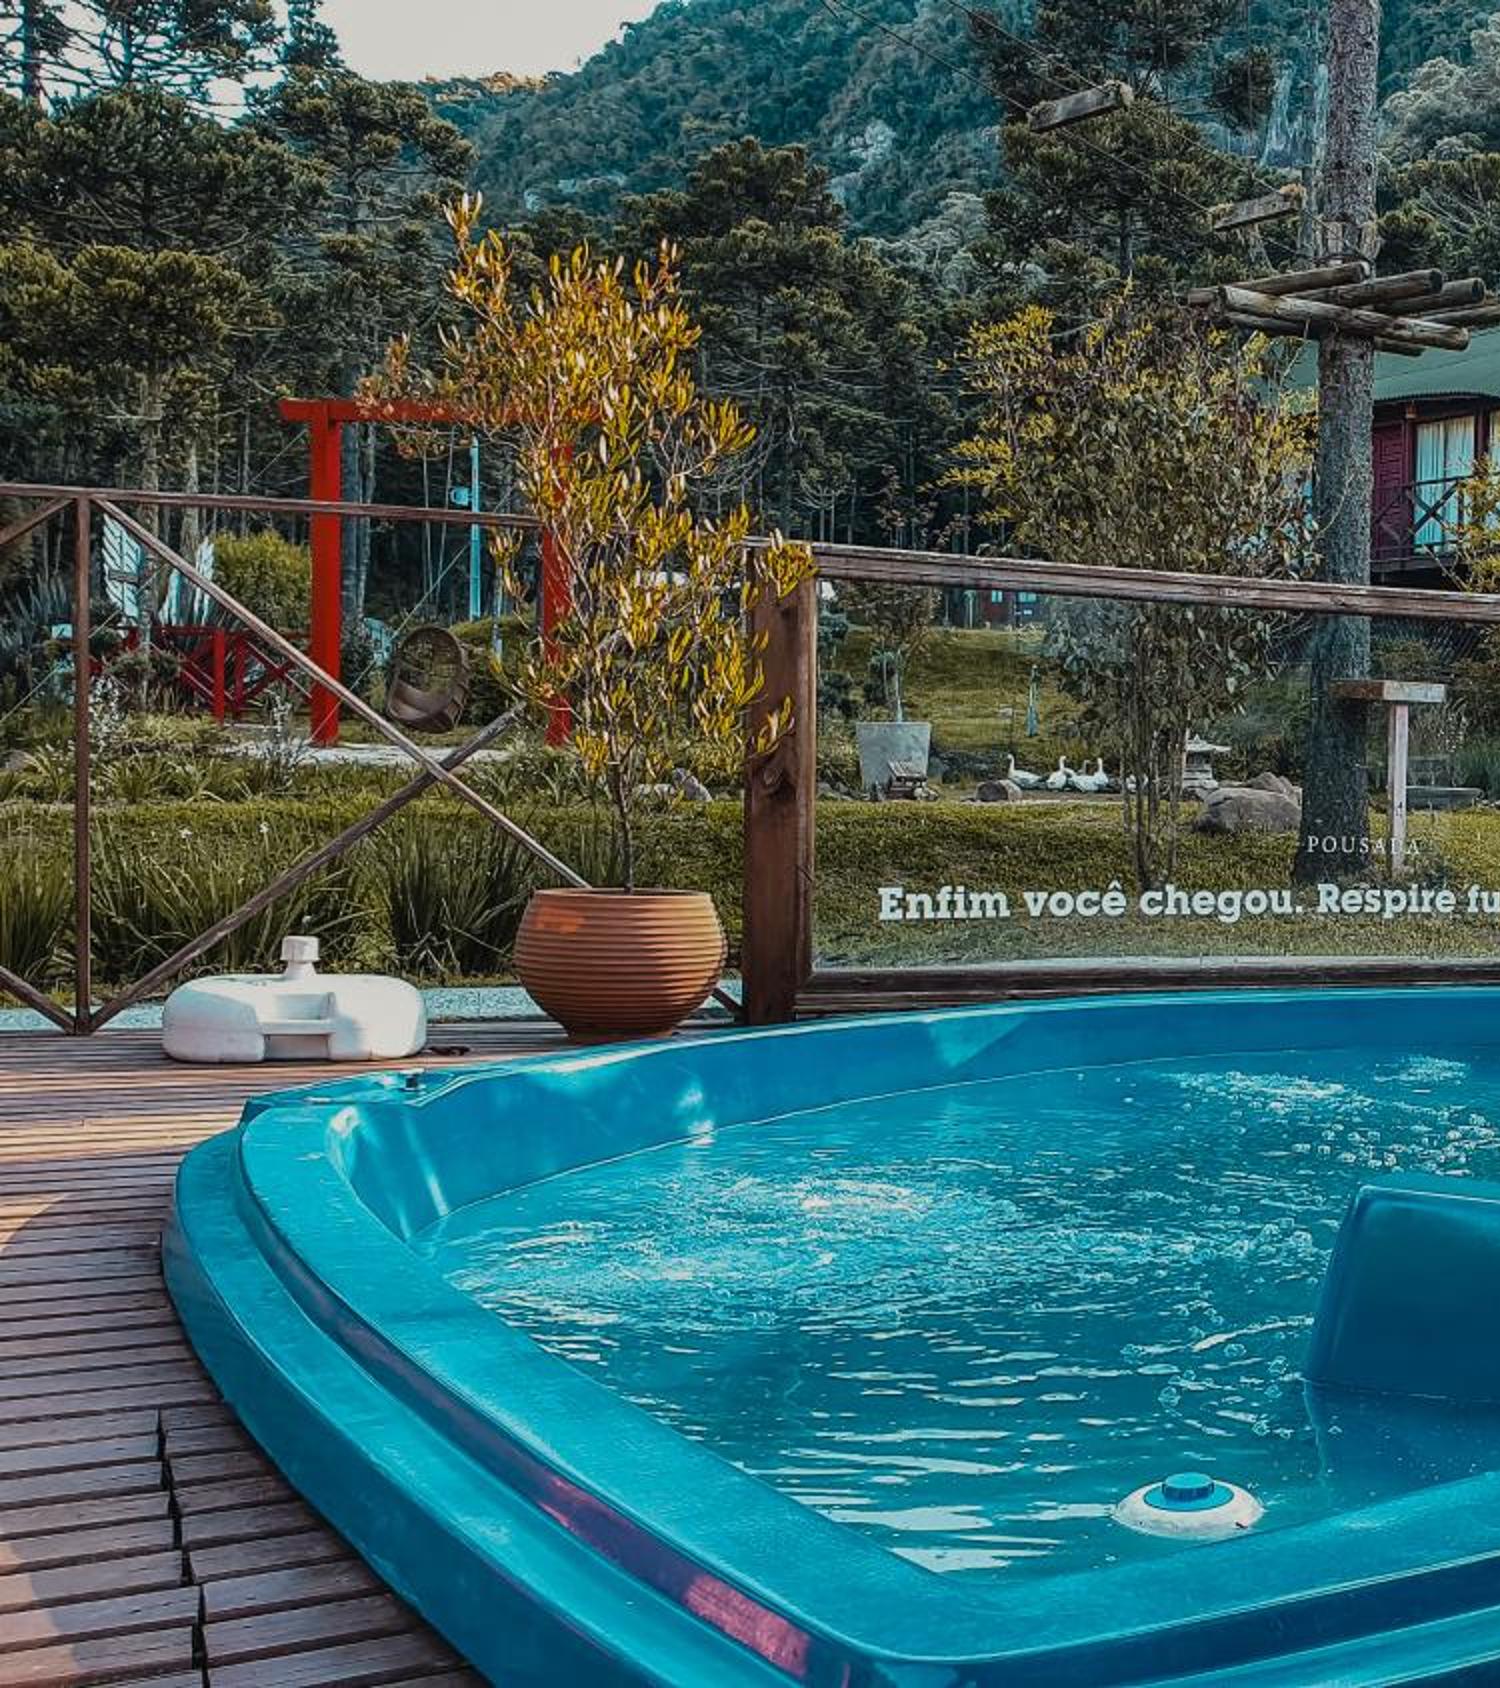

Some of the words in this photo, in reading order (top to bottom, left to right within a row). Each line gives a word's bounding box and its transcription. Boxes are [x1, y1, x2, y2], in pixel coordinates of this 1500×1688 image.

[1307, 835, 1420, 854] POUSADA
[877, 885, 1011, 920] Enfim
[1023, 879, 1127, 917] você
[1139, 883, 1302, 923] chegou.
[1317, 883, 1456, 918] Respire
